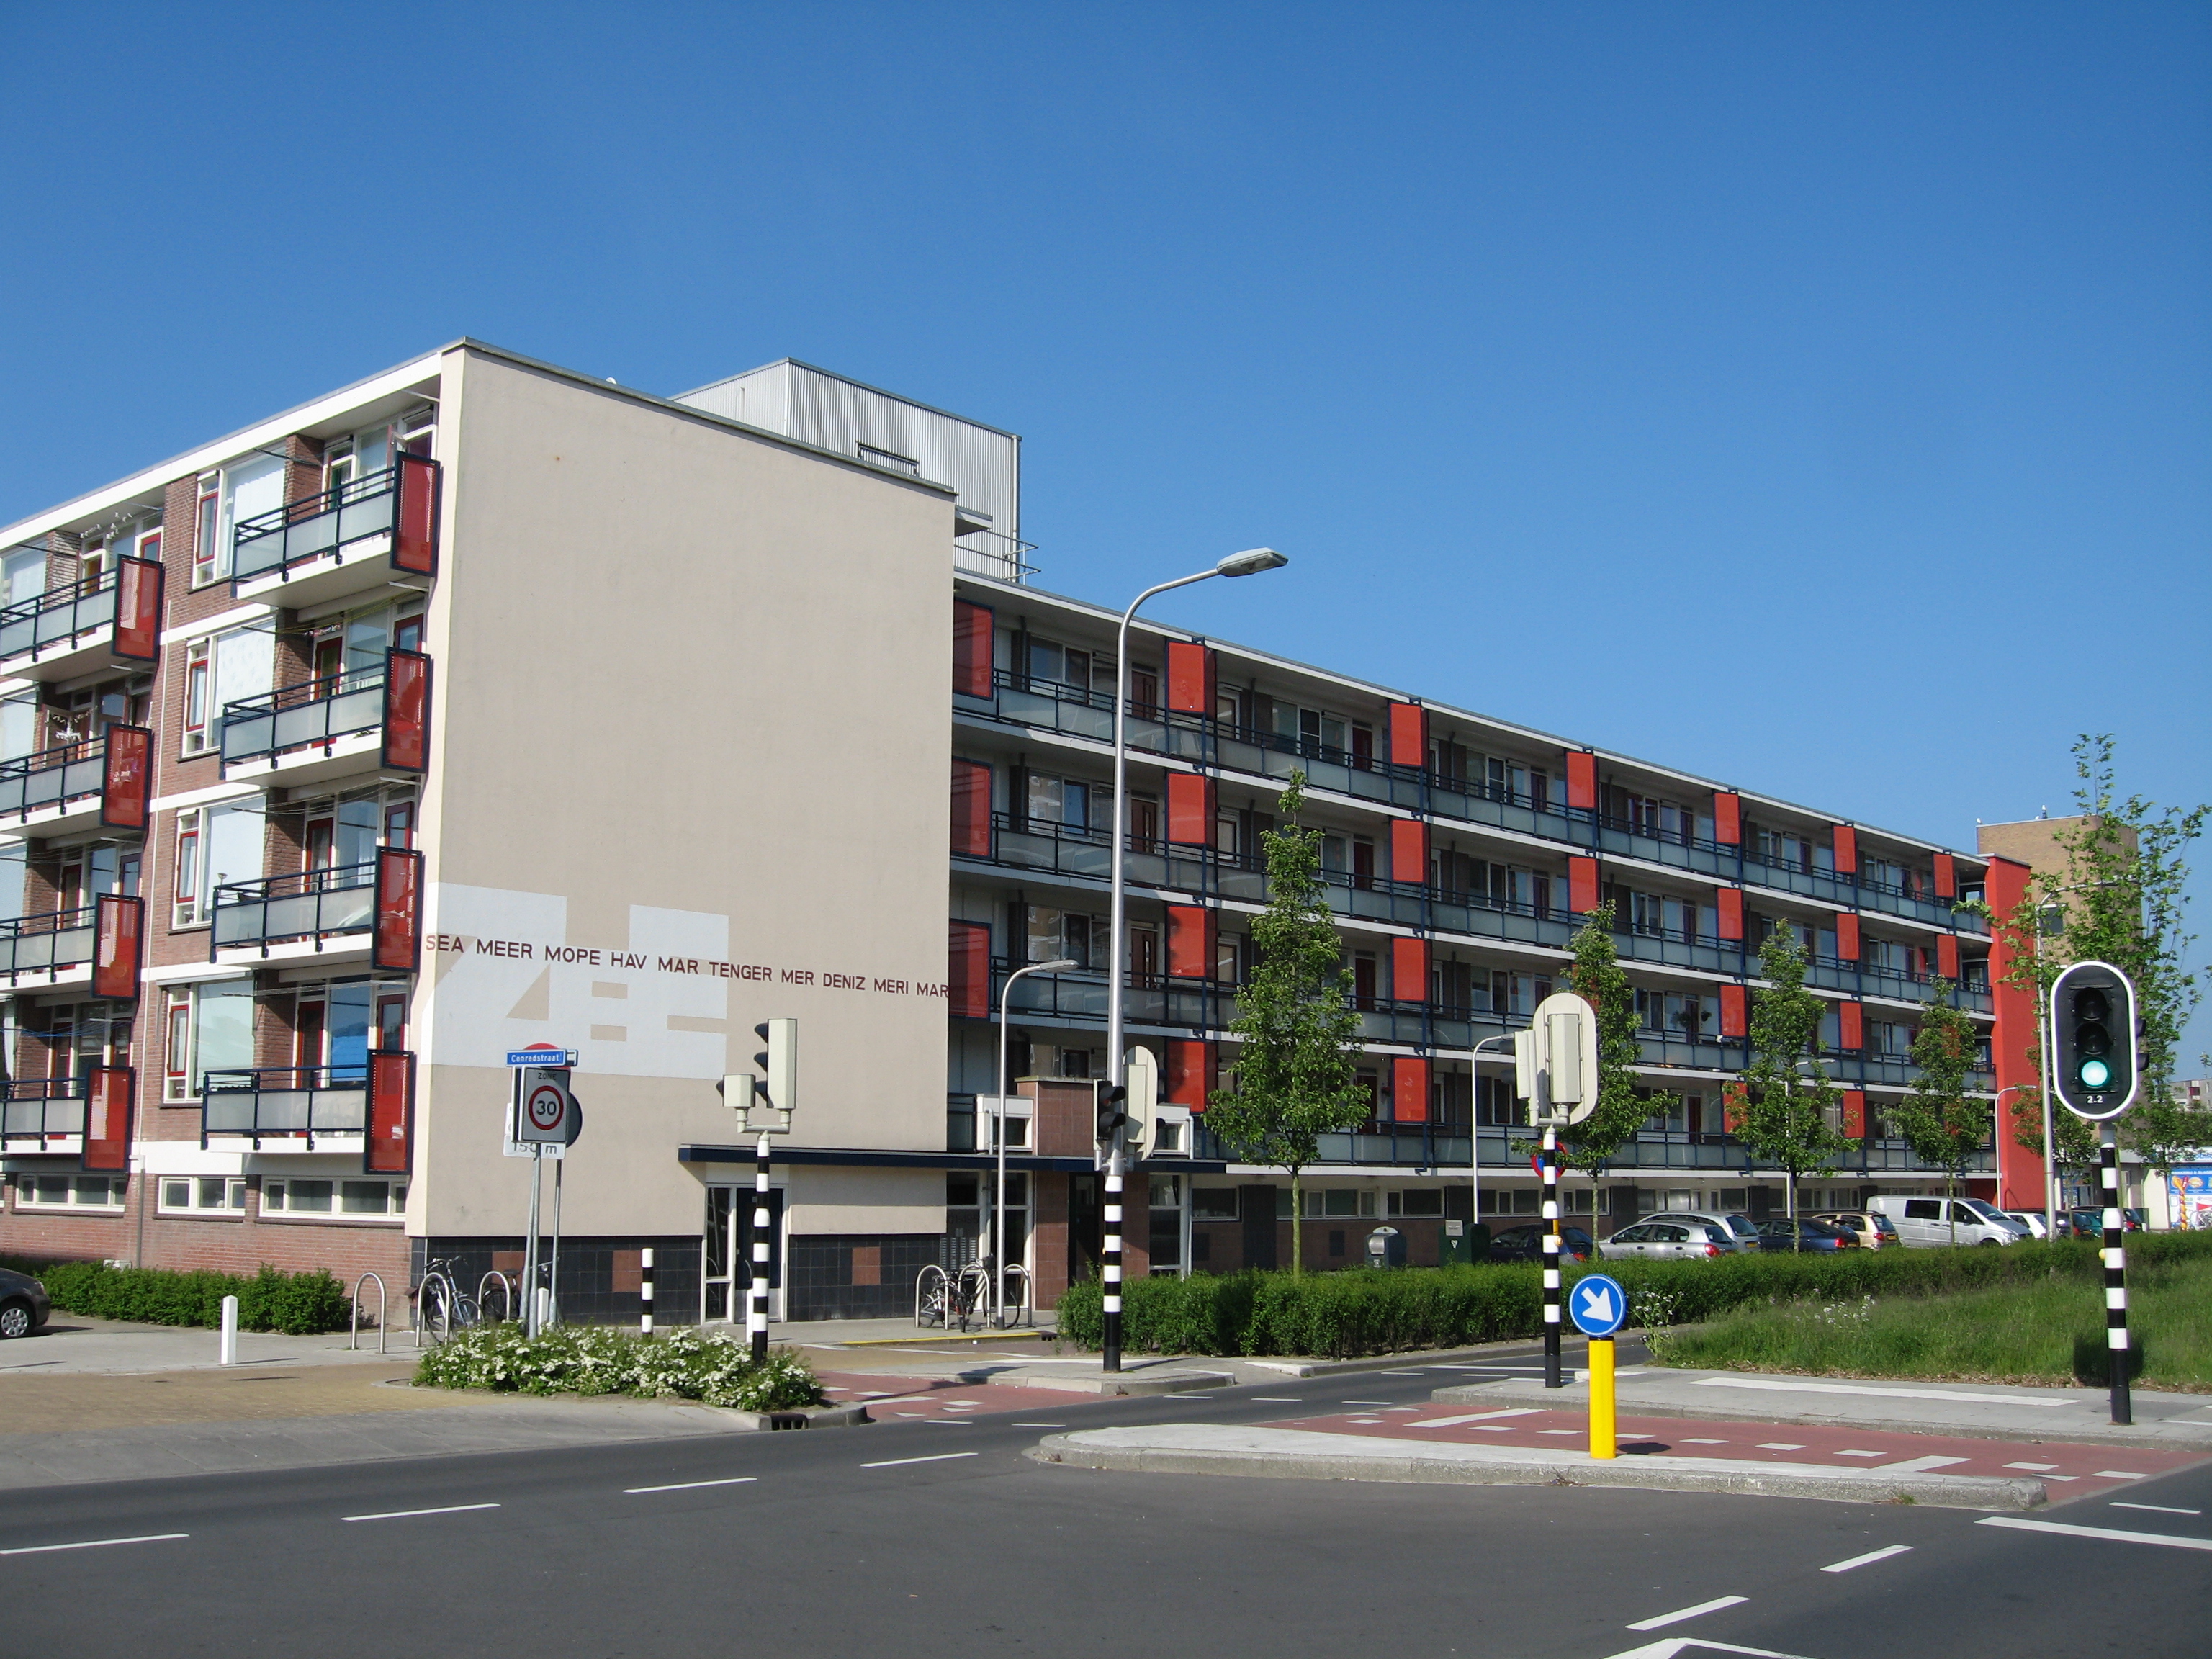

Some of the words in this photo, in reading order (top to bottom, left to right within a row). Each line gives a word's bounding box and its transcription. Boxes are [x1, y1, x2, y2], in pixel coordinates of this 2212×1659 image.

[426, 935, 464, 953] SEA
[476, 938, 533, 959] MEER
[545, 945, 601, 966] MOPE
[611, 953, 647, 970] HAV
[658, 956, 698, 975] MAR
[709, 961, 773, 982] TENGER
[781, 968, 815, 986] MER
[823, 973, 866, 991] DENIZ
[873, 978, 909, 995] MERI
[917, 982, 949, 998] MAR
[536, 1100, 557, 1116] 30
[545, 1145, 557, 1154] m
